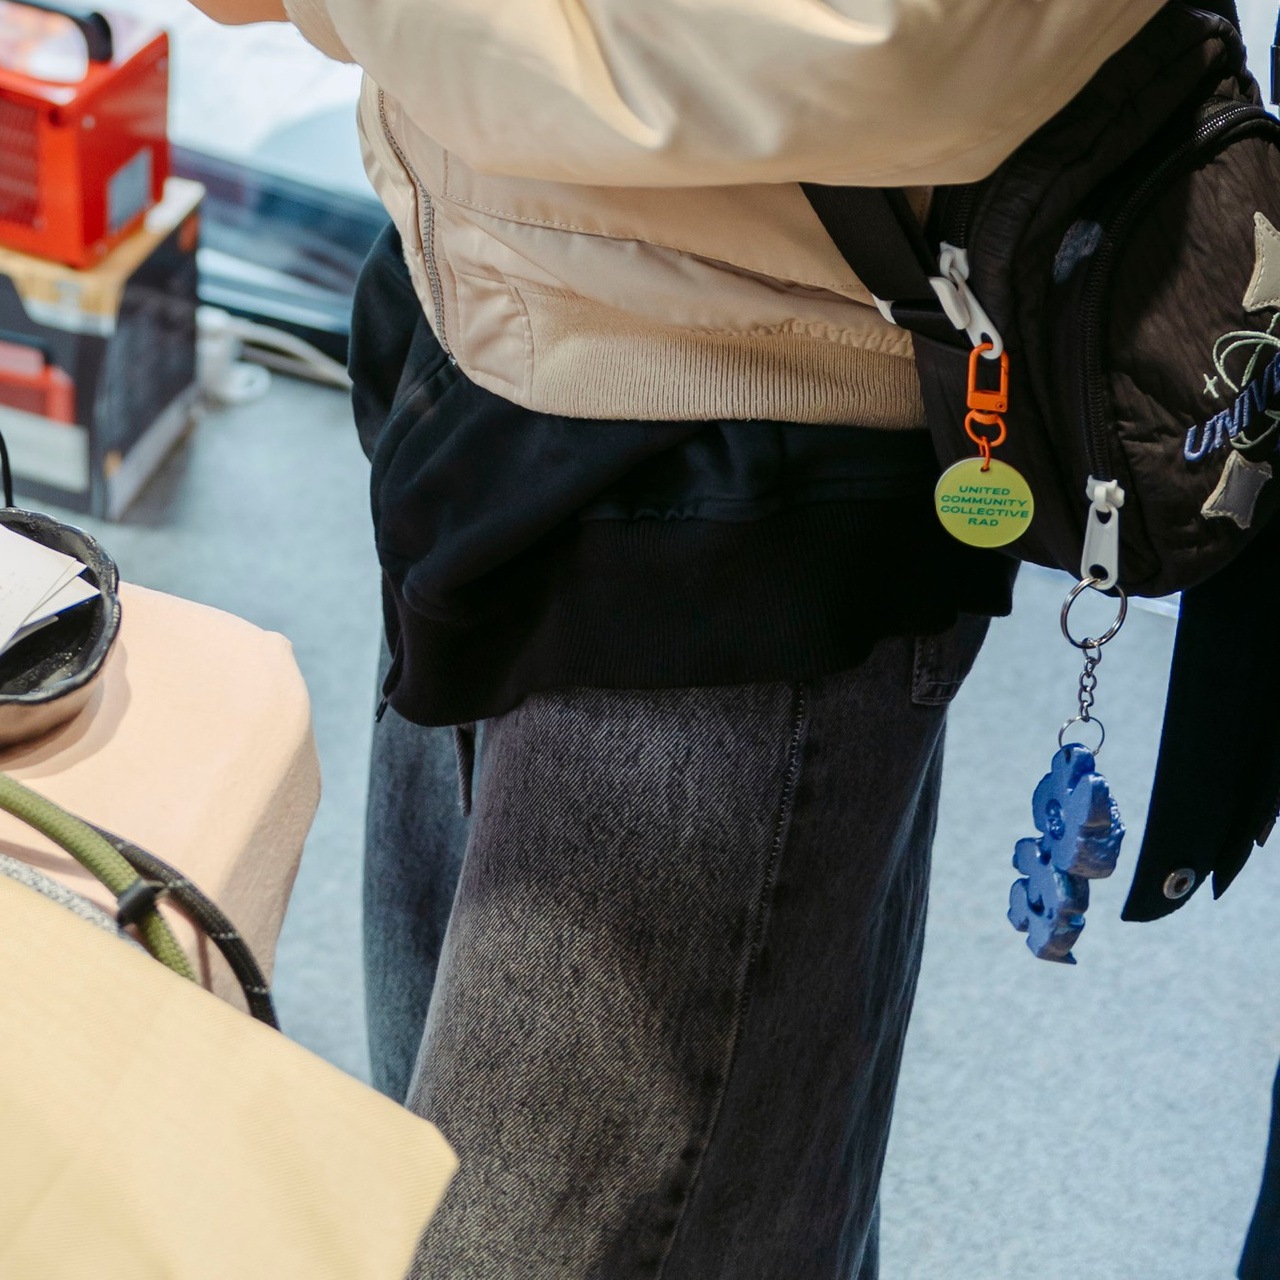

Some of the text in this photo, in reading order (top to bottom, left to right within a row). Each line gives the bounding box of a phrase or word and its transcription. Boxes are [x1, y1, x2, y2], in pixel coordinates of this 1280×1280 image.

[959, 485, 1011, 496] UNITED
[940, 494, 1028, 508] COMMUNITY
[940, 505, 1029, 519] COLLECTIVE
[968, 517, 1000, 527] RAD
